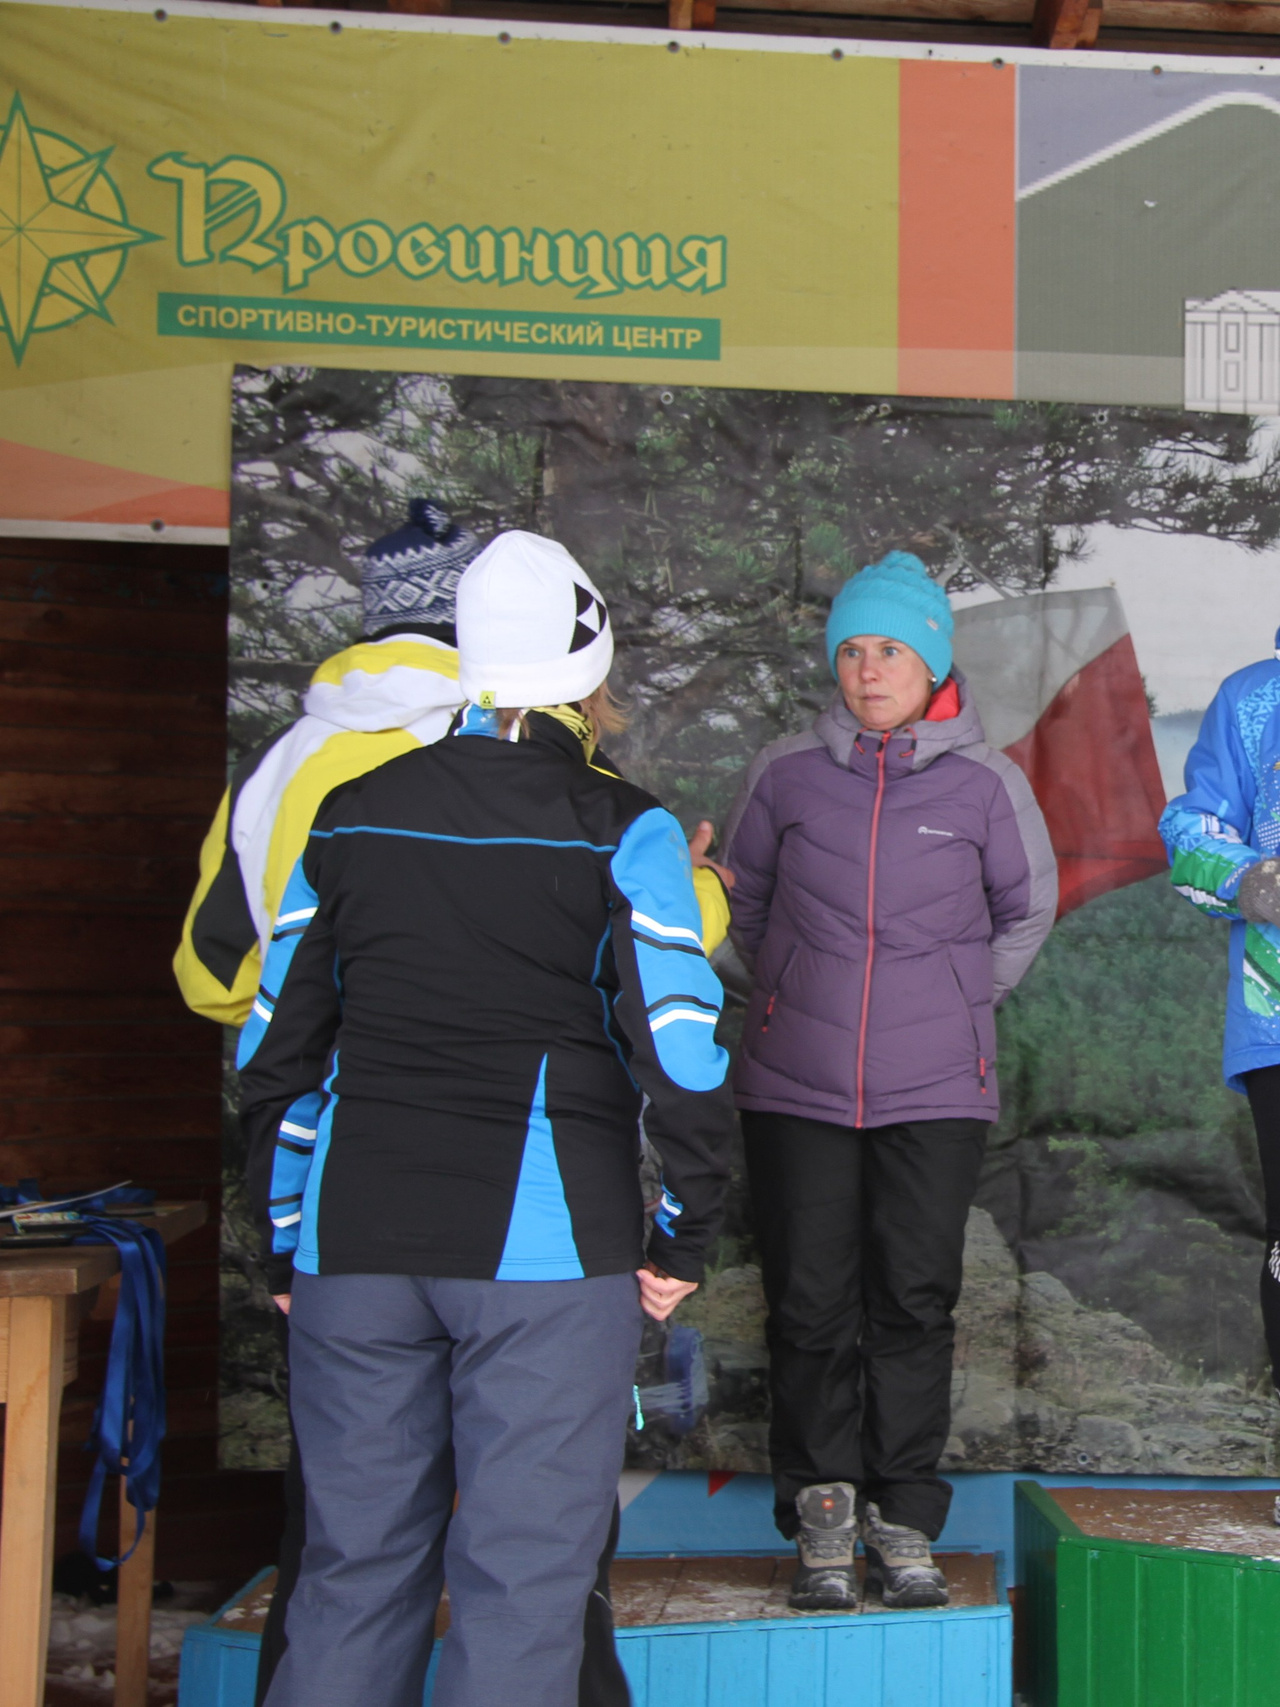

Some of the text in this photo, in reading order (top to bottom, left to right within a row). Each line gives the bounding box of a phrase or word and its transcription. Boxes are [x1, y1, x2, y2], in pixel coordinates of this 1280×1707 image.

[147, 152, 727, 300] Провинция
[177, 304, 702, 351] СПОРТИВНО-ТУРИСТИЧЕСКИЙ ЦЕНТР
